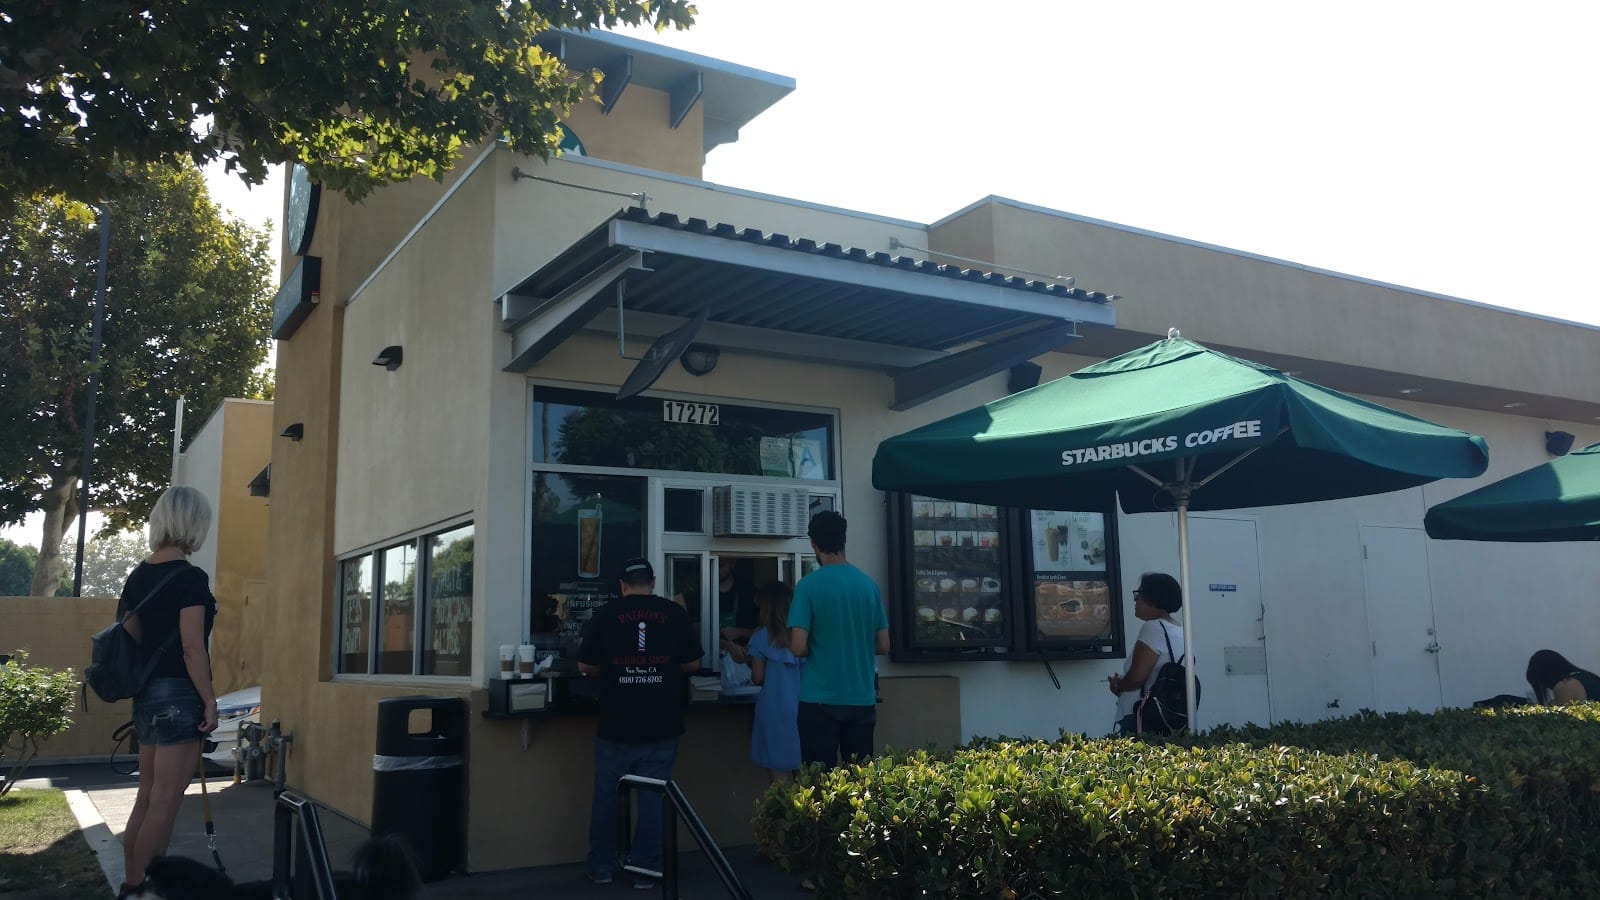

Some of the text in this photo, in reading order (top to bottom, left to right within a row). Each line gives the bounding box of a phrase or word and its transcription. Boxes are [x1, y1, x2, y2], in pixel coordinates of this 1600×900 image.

[665, 401, 718, 425] 17272
[1061, 419, 1262, 466] STARBUCKS COFFEE
[635, 675, 663, 684] 776-8702
